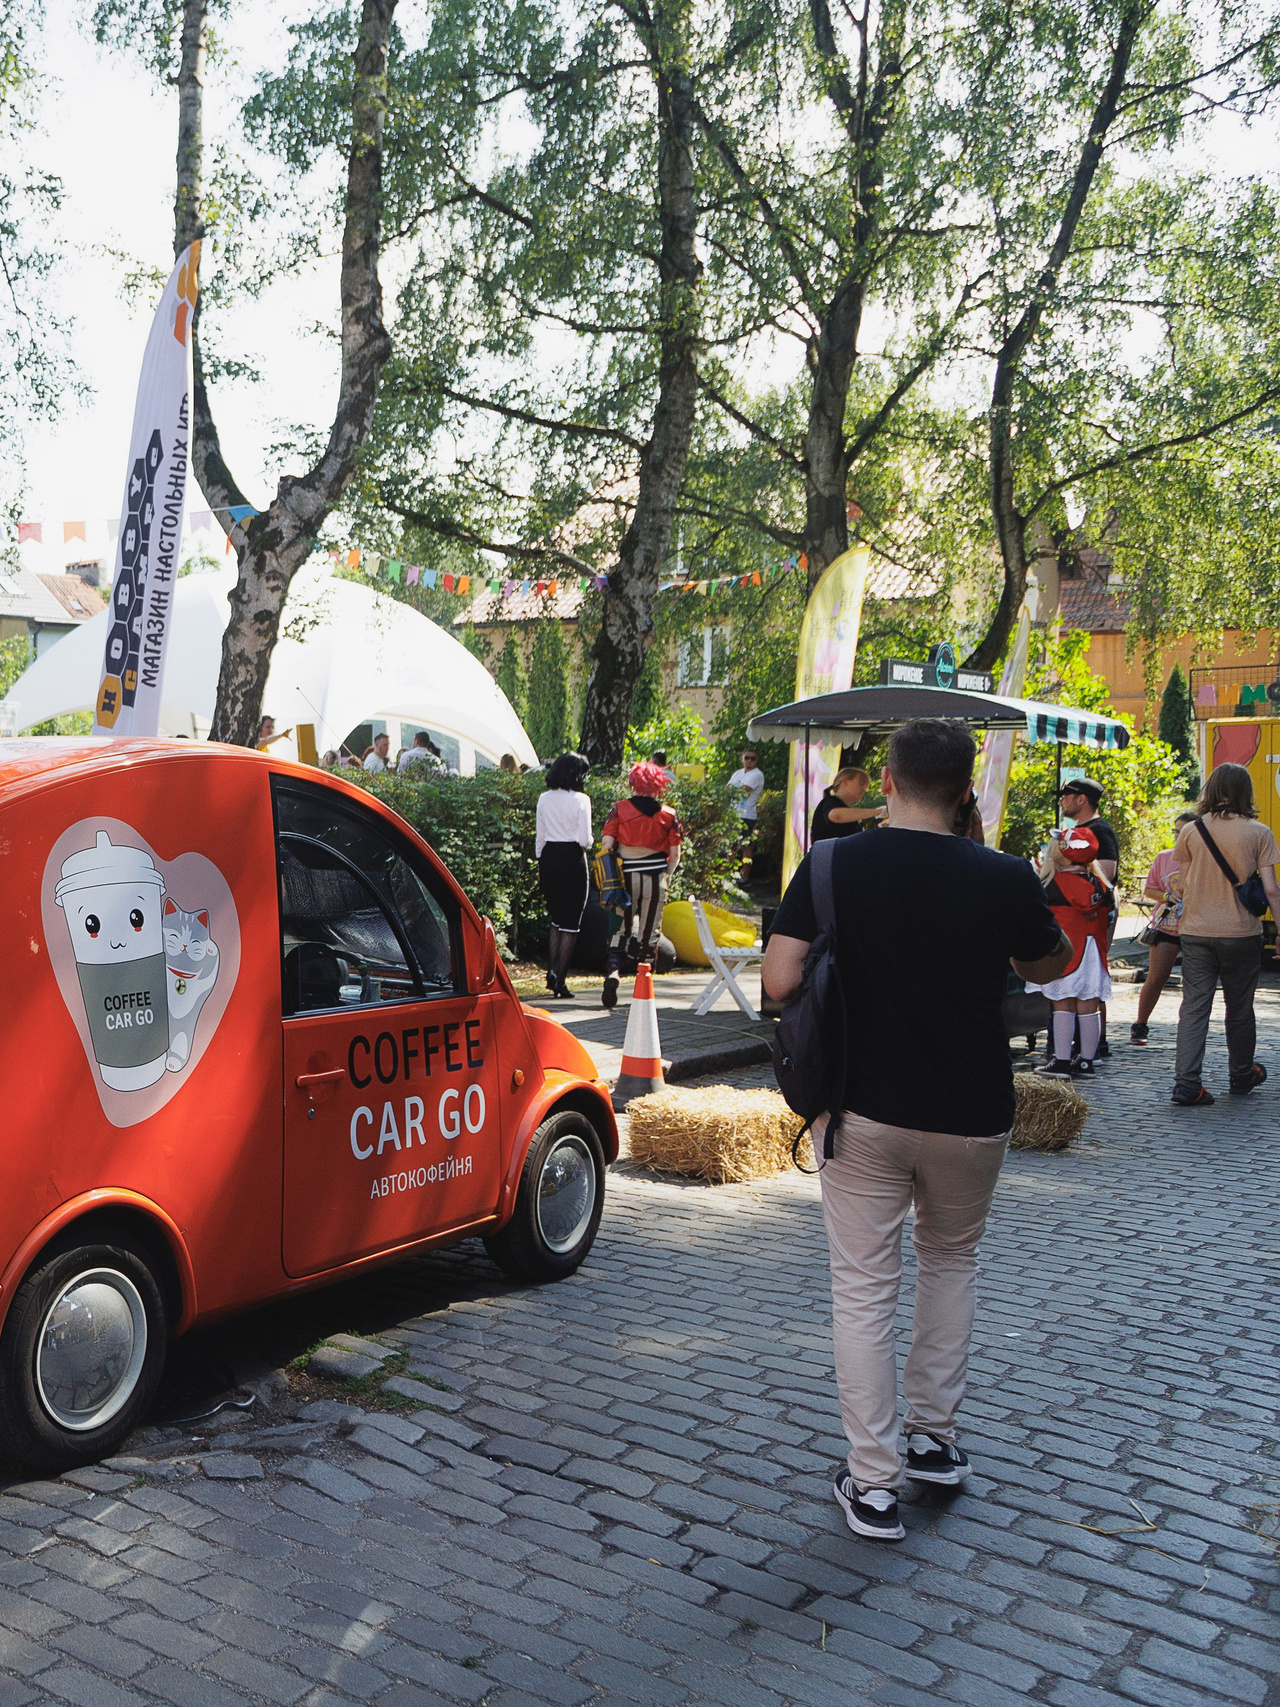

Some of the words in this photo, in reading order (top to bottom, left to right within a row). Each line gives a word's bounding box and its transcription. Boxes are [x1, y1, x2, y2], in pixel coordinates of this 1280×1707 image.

[155, 439, 188, 583] НАСТОЛЬНЫХ
[100, 476, 142, 714] HOBBY
[141, 583, 170, 688] МАГАЗИН
[104, 991, 152, 1011] COFFEE
[105, 1012, 133, 1031] CAR
[135, 1008, 154, 1026] GO
[348, 1019, 484, 1089] COFFEE
[350, 1095, 427, 1160] CAR
[438, 1083, 486, 1139] GO
[370, 1155, 473, 1199] АВТОКОФЕЙНЯ
